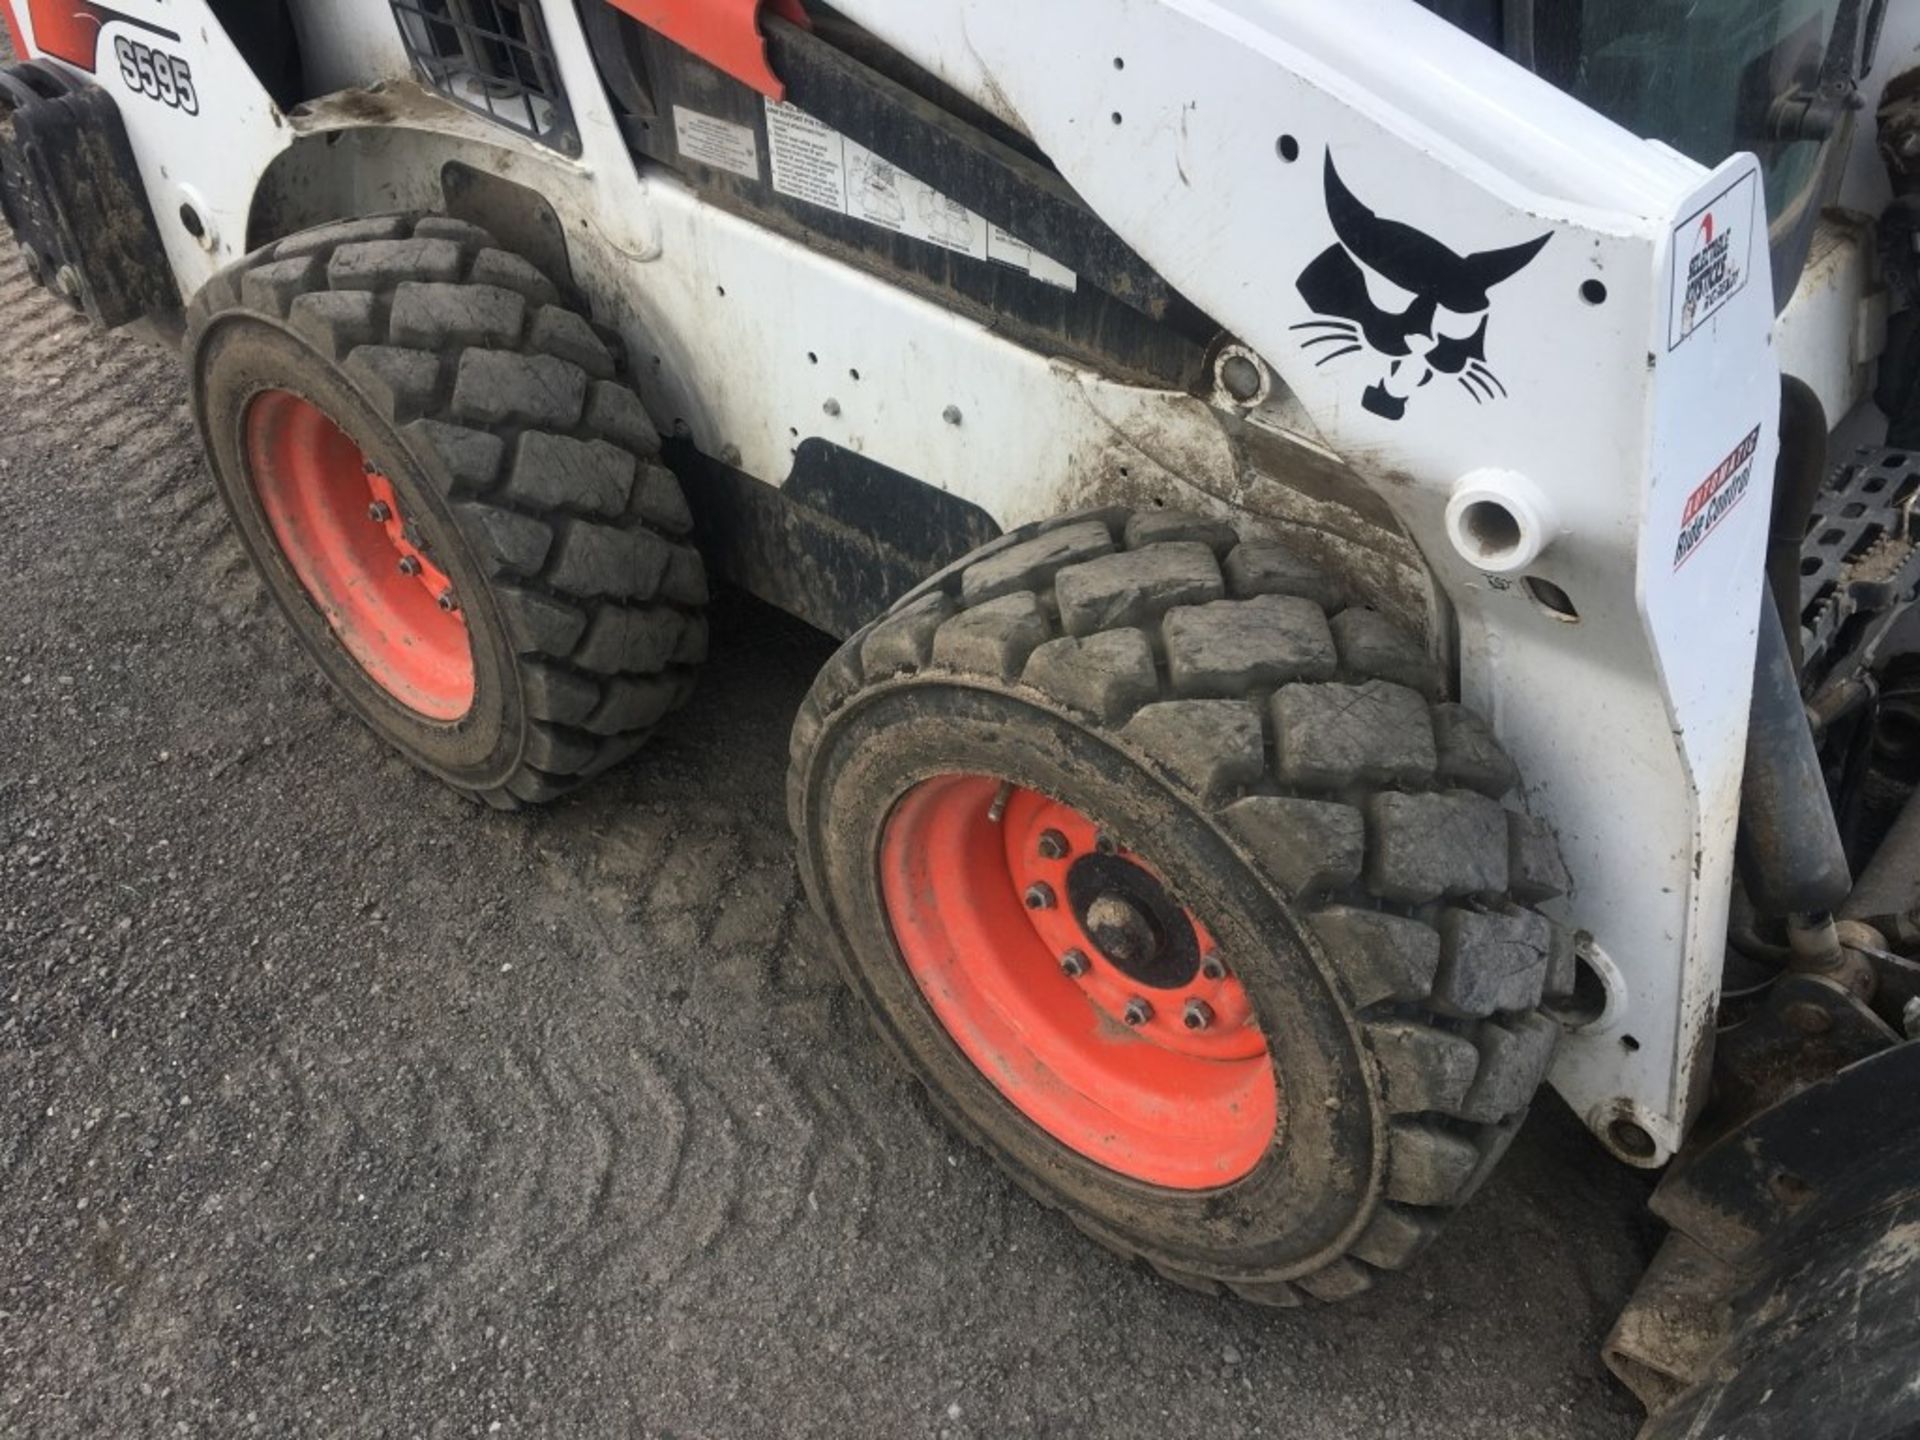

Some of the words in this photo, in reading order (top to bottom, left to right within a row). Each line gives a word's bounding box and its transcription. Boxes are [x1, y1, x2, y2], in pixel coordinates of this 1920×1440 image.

[114, 35, 199, 116] S595
[1674, 513, 1705, 565] Ride
[1705, 456, 1754, 530] Control
